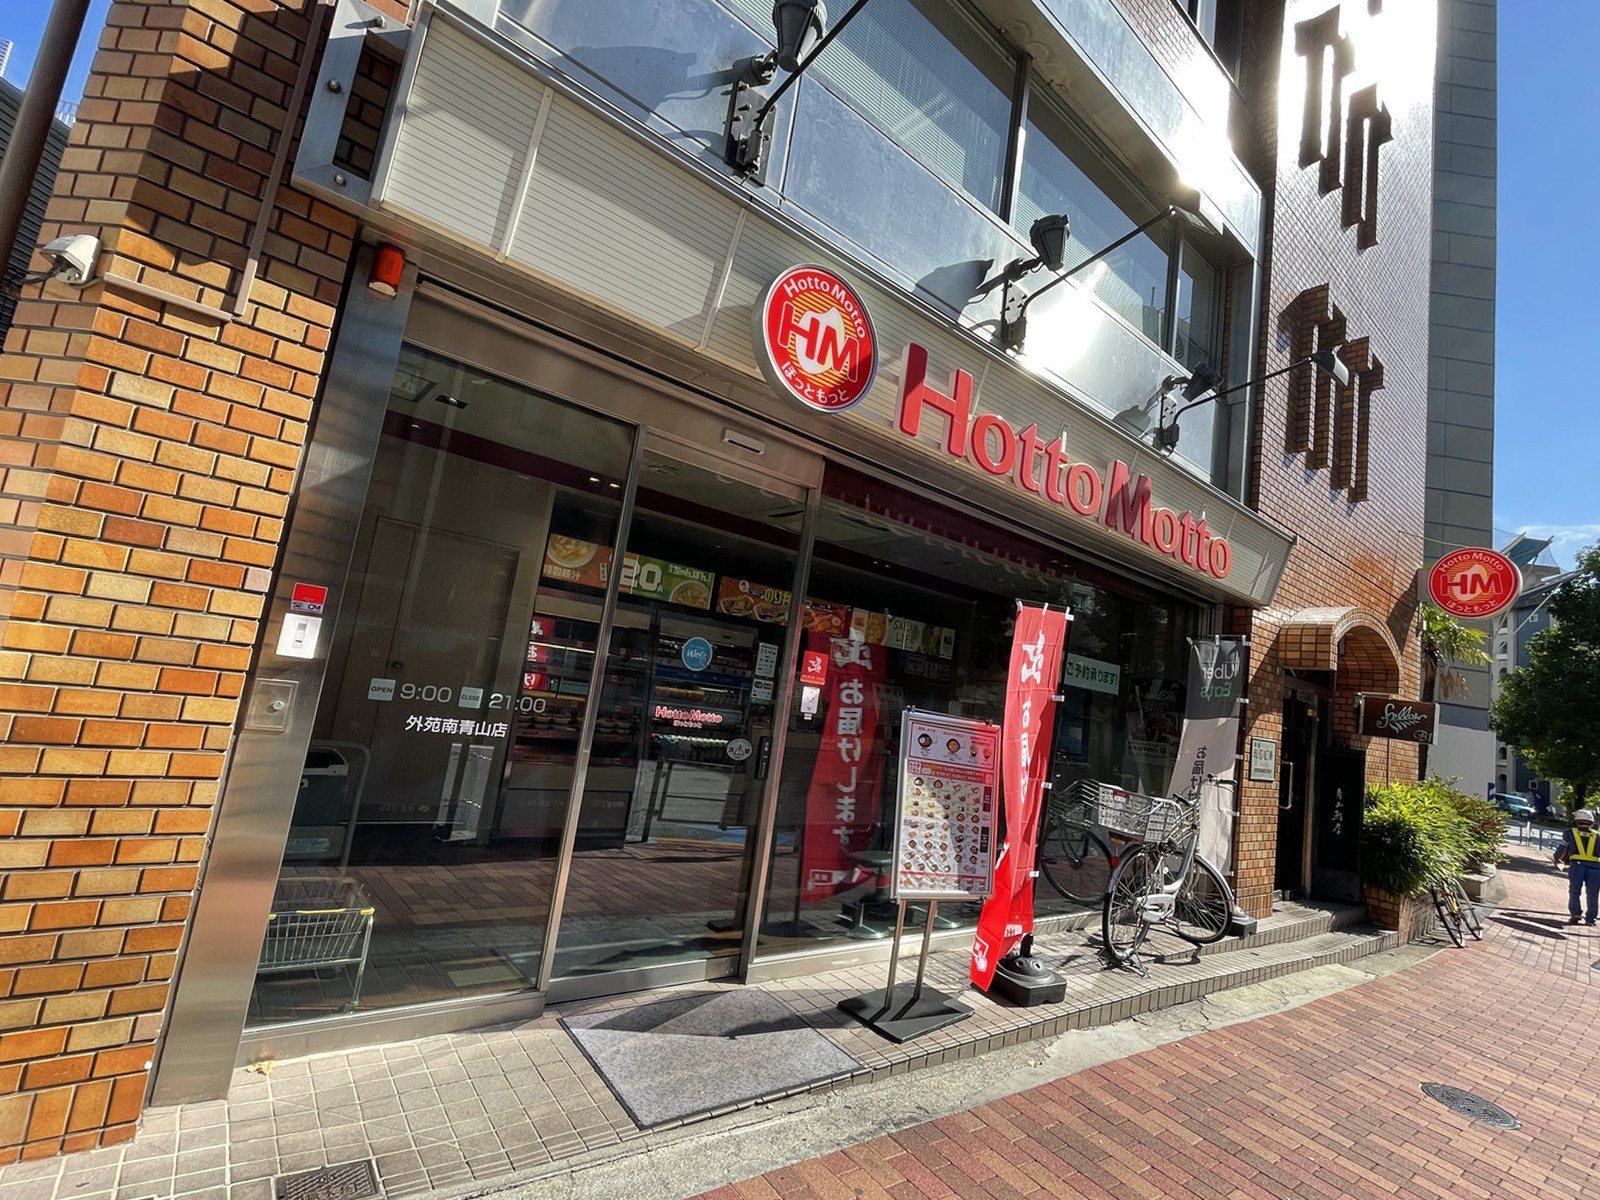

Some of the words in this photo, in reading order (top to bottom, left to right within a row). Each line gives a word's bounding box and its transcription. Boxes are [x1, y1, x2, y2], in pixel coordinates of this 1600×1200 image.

[783, 276, 830, 298] Hotto
[831, 284, 866, 339] Motto
[777, 300, 860, 383] HM
[781, 361, 850, 404] ほっともっと
[894, 342, 1103, 516] Hotto
[1099, 459, 1233, 579] Motto
[1438, 553, 1470, 573] Hotto
[1471, 552, 1504, 571] Motto
[1440, 571, 1504, 597] HM
[370, 685, 393, 694] OPEN
[400, 683, 452, 703] 9:00
[461, 694, 480, 702] CLOSE
[488, 693, 547, 713] 21:00
[405, 714, 508, 738] 外苑南青山店
[655, 705, 690, 720] Hotto
[689, 709, 723, 723] Motto
